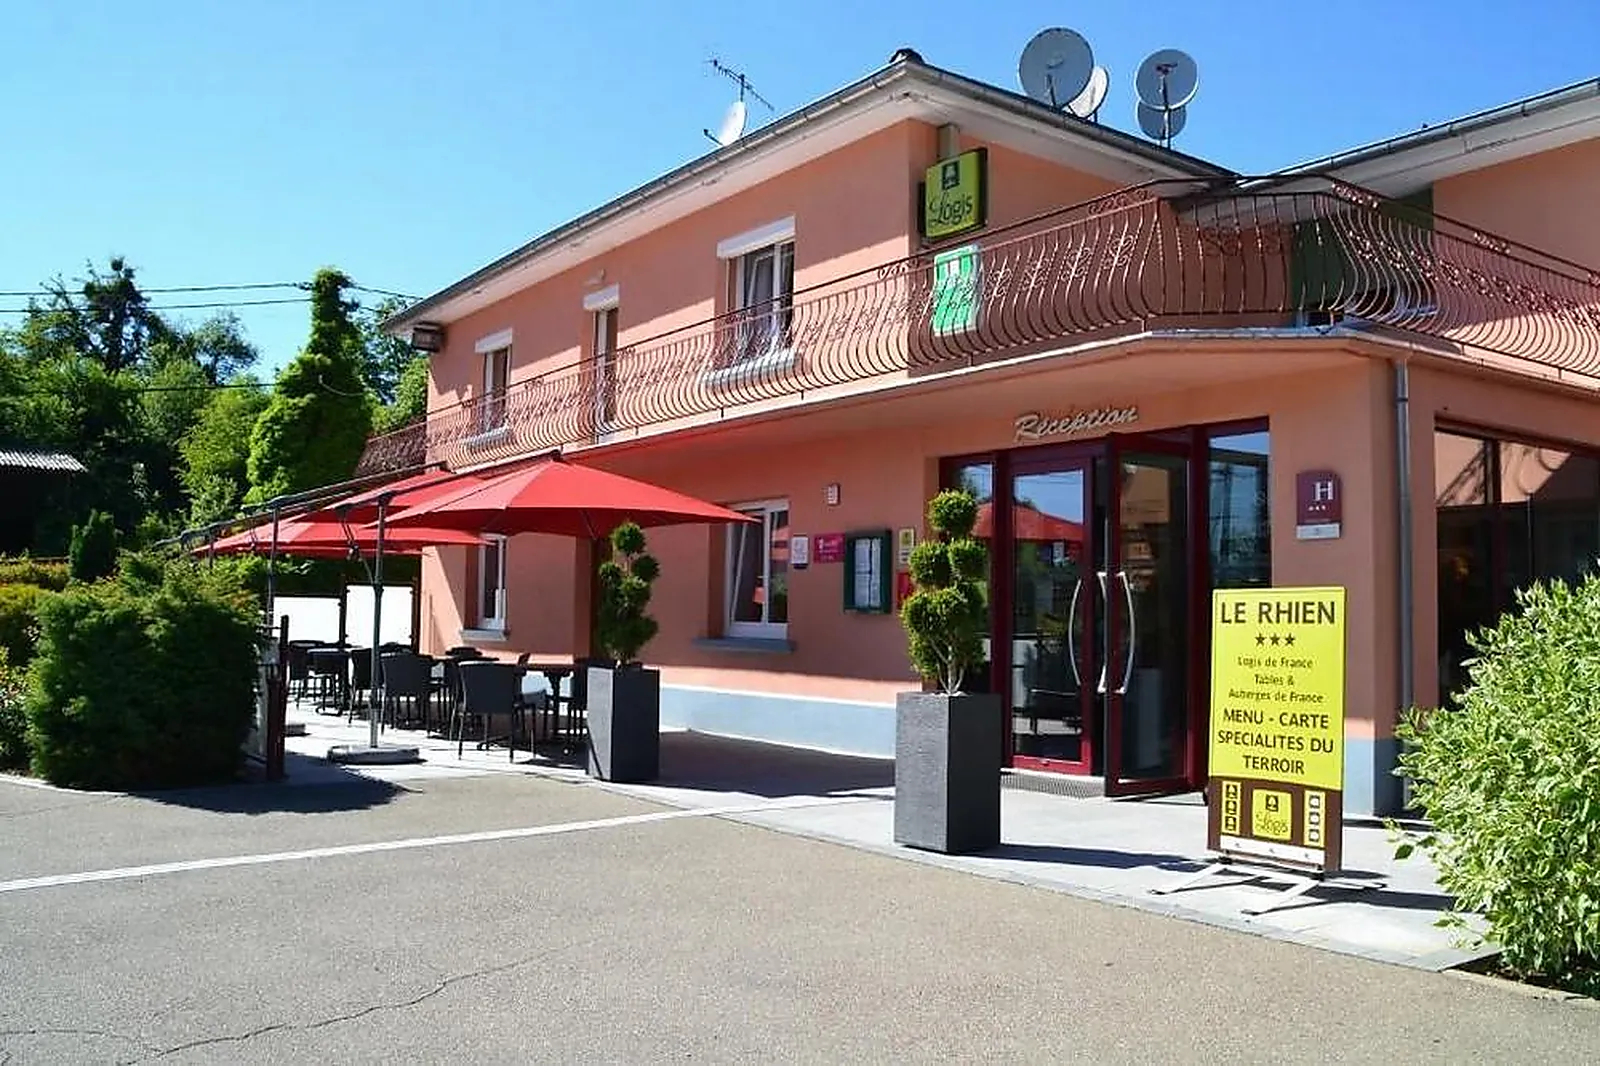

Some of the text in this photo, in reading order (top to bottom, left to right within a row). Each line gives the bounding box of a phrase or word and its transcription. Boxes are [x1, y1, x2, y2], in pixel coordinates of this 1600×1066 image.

[928, 191, 973, 226] Logis
[1315, 480, 1333, 501] H
[1221, 601, 1335, 624] LE RHIEN
[1238, 656, 1313, 669] Logis de France
[1255, 674, 1294, 686] Tables &
[1228, 688, 1324, 703] Auberges de France
[1223, 708, 1264, 725] MENU
[1279, 712, 1329, 729] CARTE
[1218, 730, 1334, 753] SPECIALITES DU
[1242, 755, 1305, 775] TERROIR
